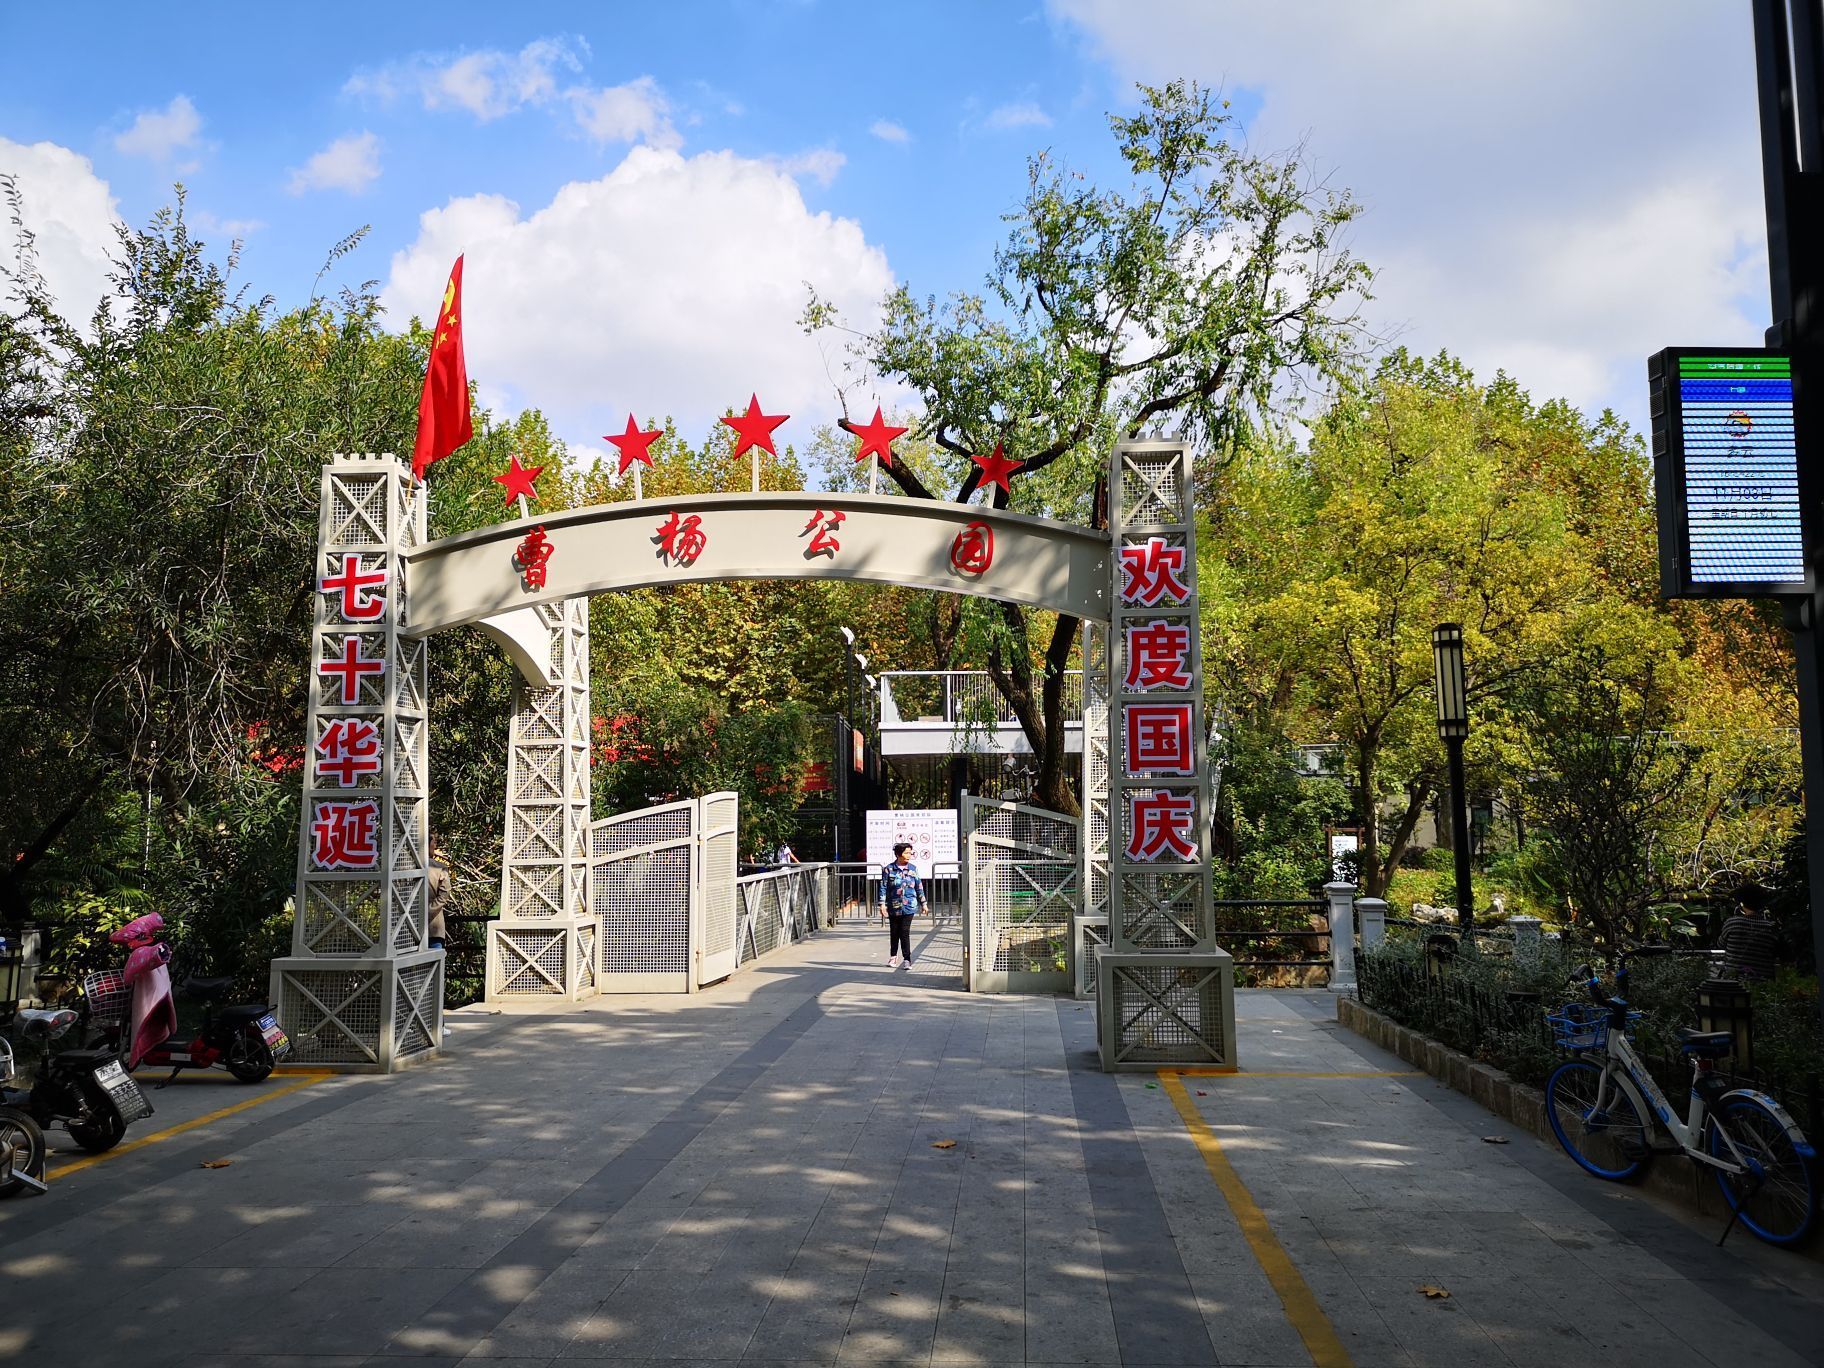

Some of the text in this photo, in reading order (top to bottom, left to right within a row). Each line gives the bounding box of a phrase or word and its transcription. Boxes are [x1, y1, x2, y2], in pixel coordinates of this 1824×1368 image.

[516, 508, 994, 588] 曹杨公园
[1120, 538, 1197, 861] 欢度国庆
[312, 554, 388, 867] 七十华诞
